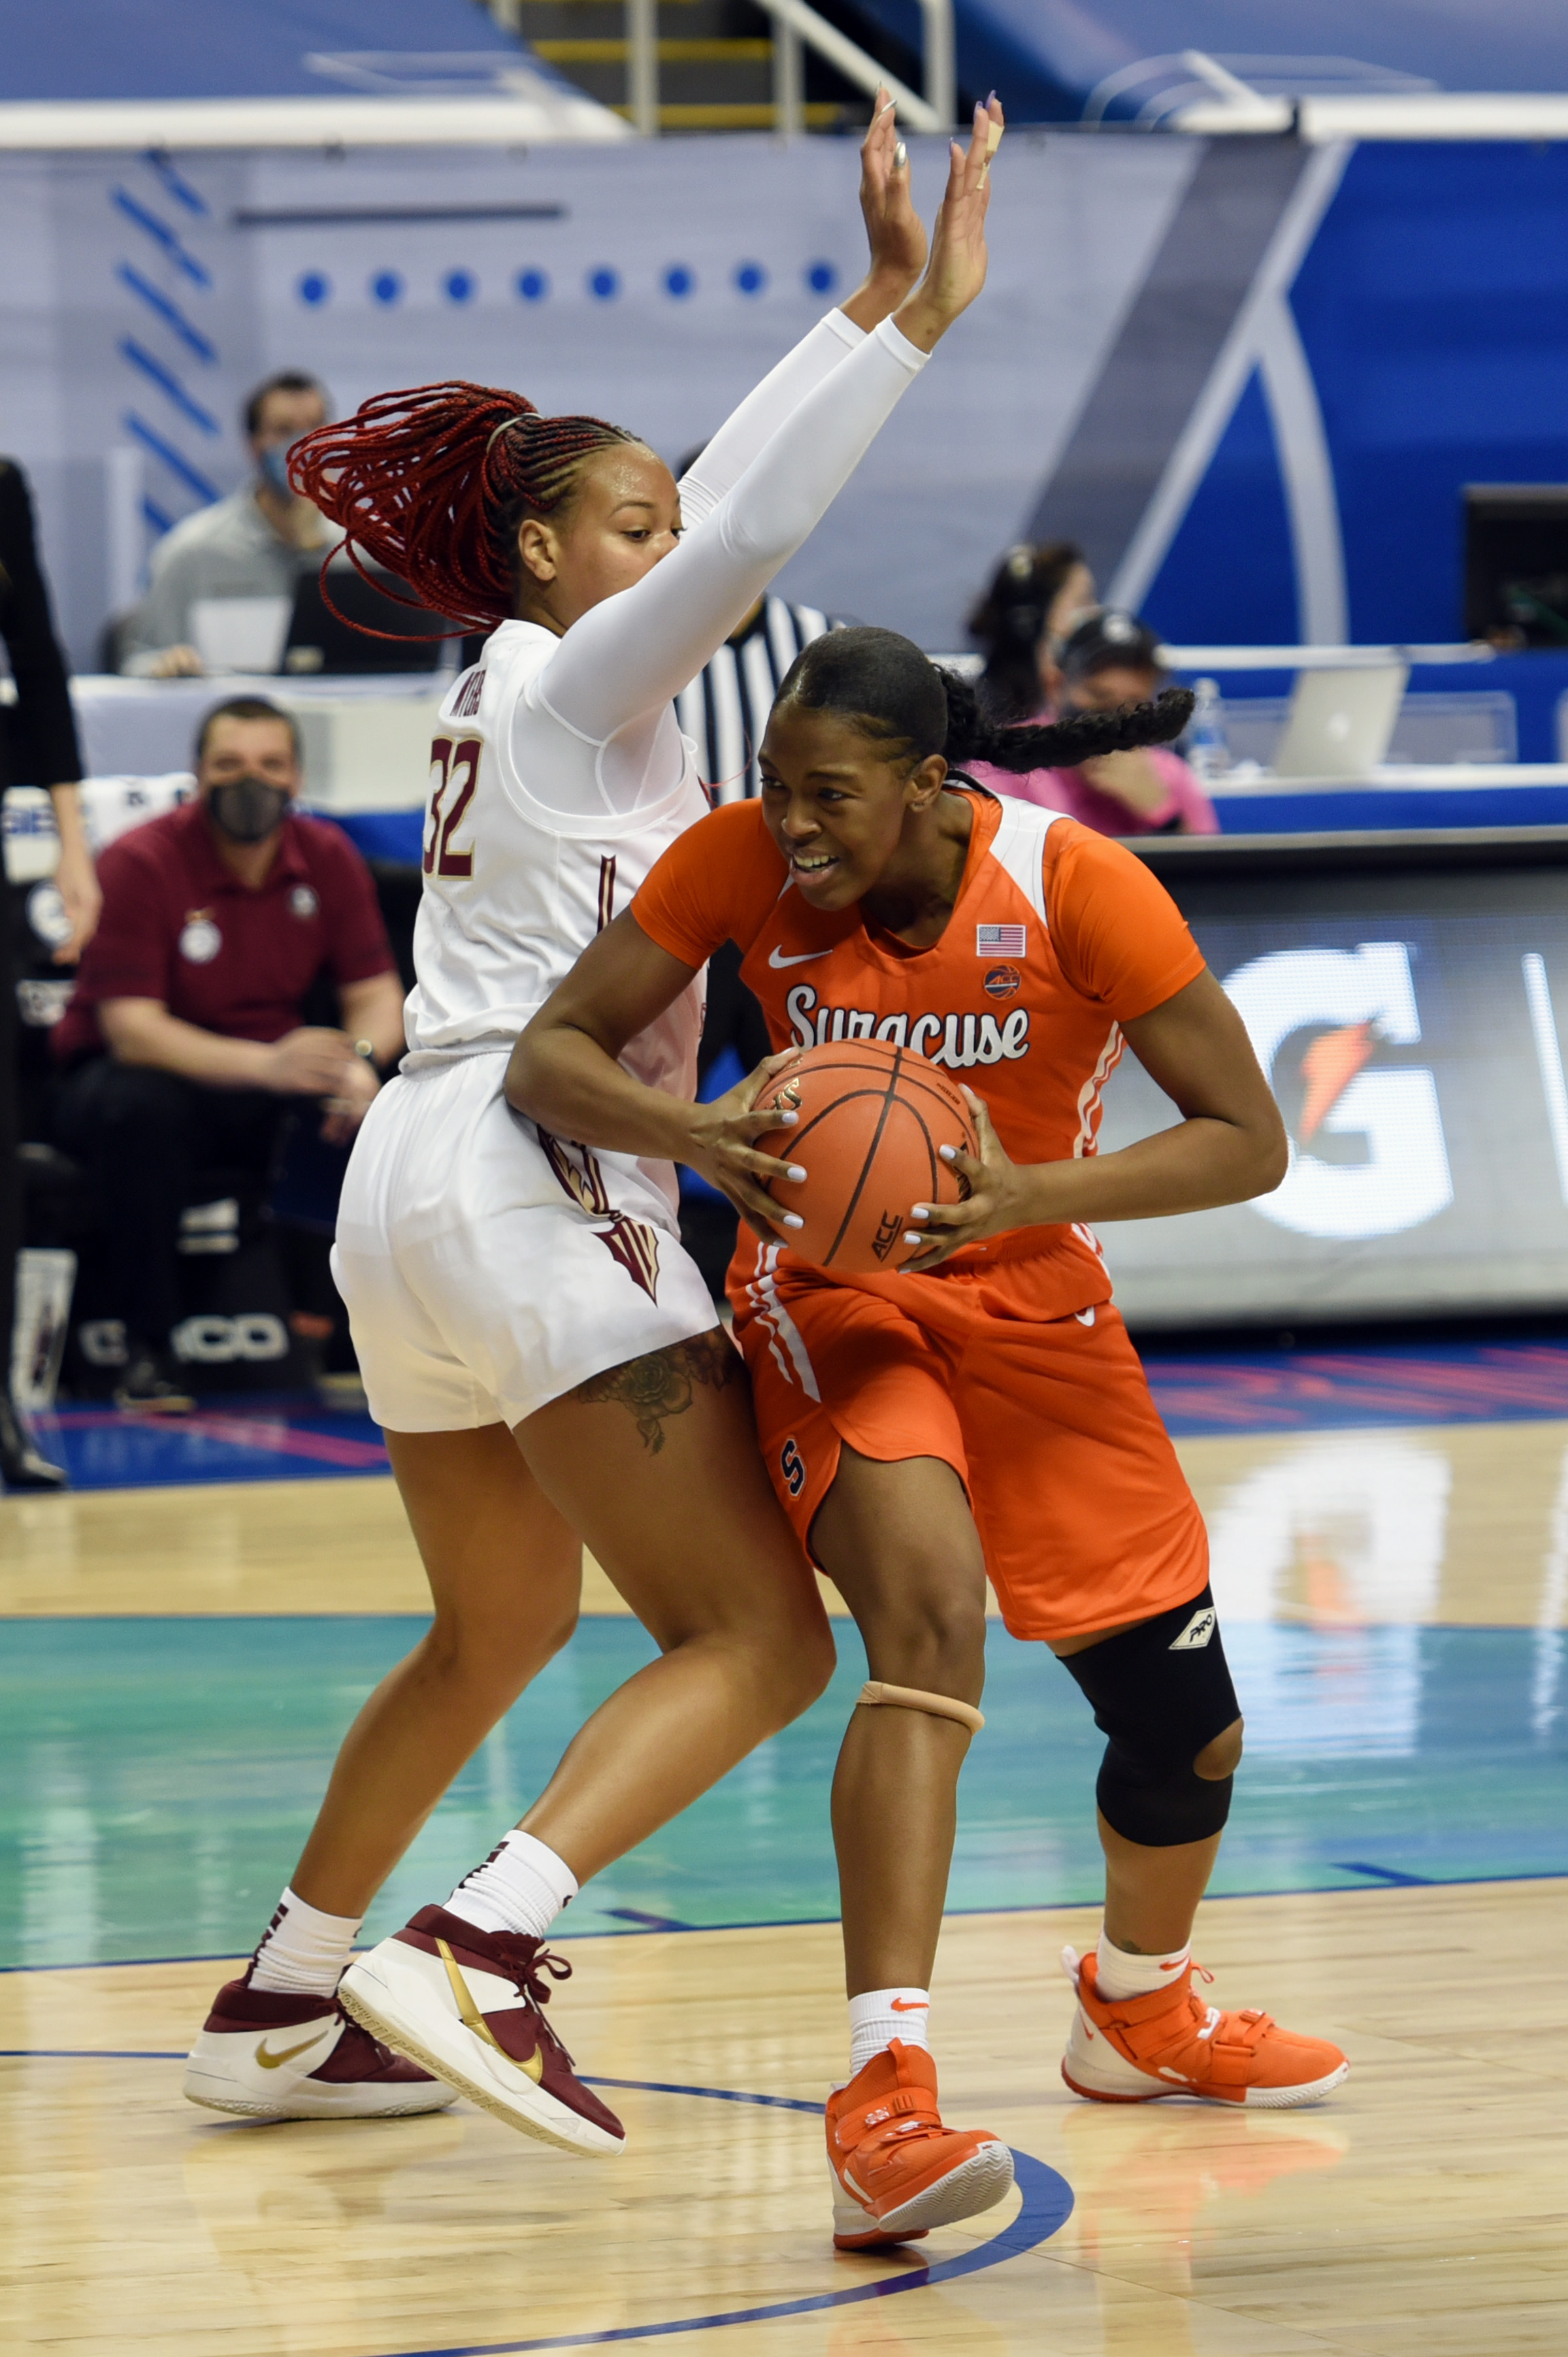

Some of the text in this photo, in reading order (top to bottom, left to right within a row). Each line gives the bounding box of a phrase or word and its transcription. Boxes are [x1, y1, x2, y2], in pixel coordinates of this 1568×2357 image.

[421, 734, 485, 882] 32
[871, 1209, 902, 1261] ACC
[780, 1438, 806, 1498] S
